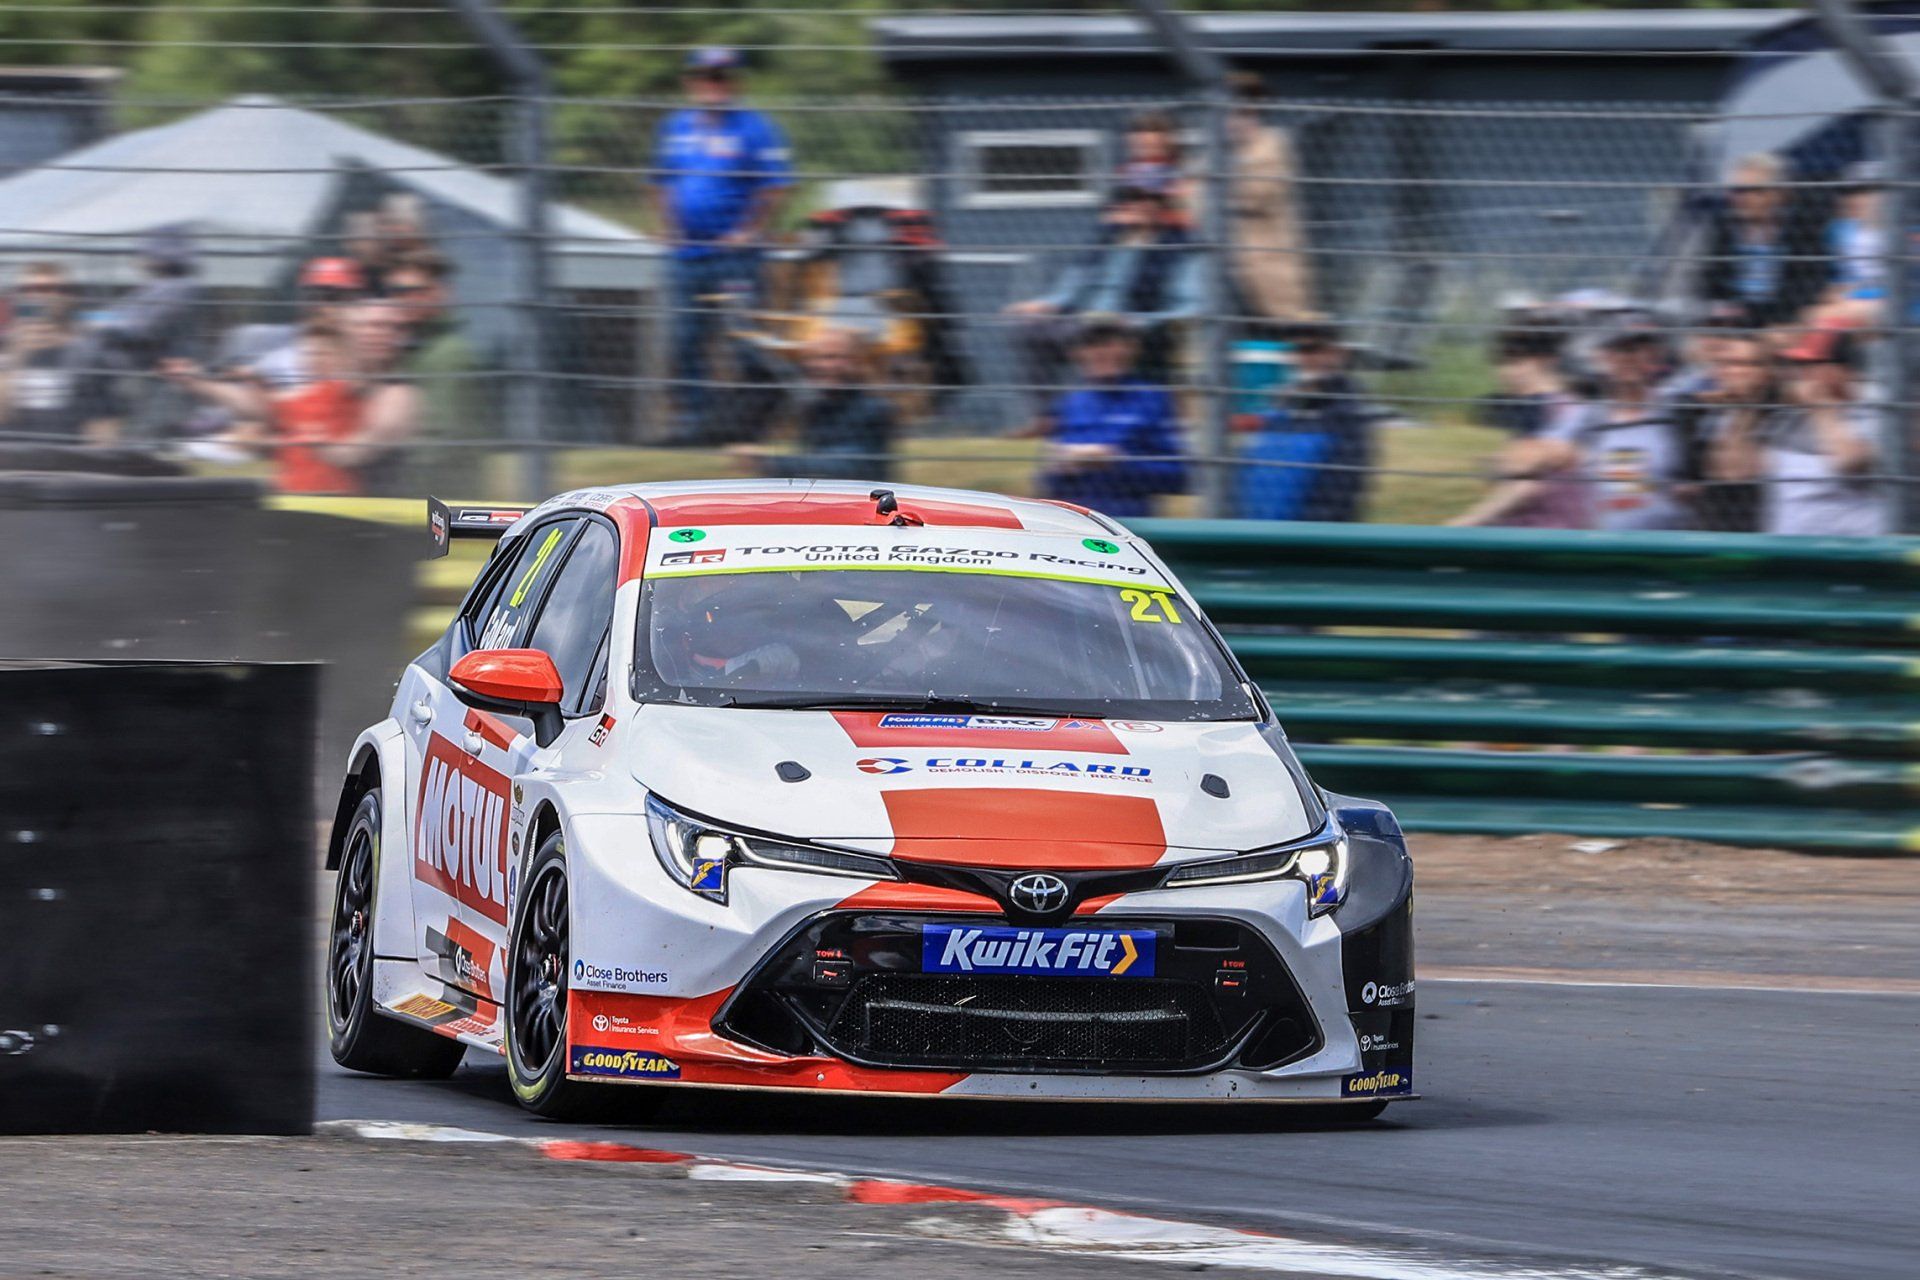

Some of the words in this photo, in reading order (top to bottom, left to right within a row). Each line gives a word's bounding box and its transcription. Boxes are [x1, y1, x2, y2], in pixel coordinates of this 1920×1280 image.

[661, 552, 725, 566] GR
[735, 545, 879, 555] TOYOTA
[891, 545, 1019, 560] GAZOO
[1029, 553, 1147, 575] Racing
[805, 553, 880, 562] United
[888, 553, 992, 565] Kingdom
[1120, 589, 1182, 624] 21
[976, 718, 1047, 727] BTCC
[926, 758, 1151, 777] COLLARD
[1016, 769, 1079, 777] DISPOSE
[1090, 773, 1153, 784] RECYCLE
[418, 755, 505, 907] MOTUL
[586, 965, 612, 980] Close
[615, 968, 668, 983] Brothers
[586, 979, 602, 988] Asset
[603, 981, 626, 990] Finance
[1378, 984, 1399, 999] Close
[612, 1016, 629, 1025] Toyota
[612, 1025, 636, 1034] Insurance
[638, 1026, 659, 1035] Services
[583, 1051, 669, 1074] GOODYEAR
[1349, 1070, 1400, 1094] GOODYEAR
